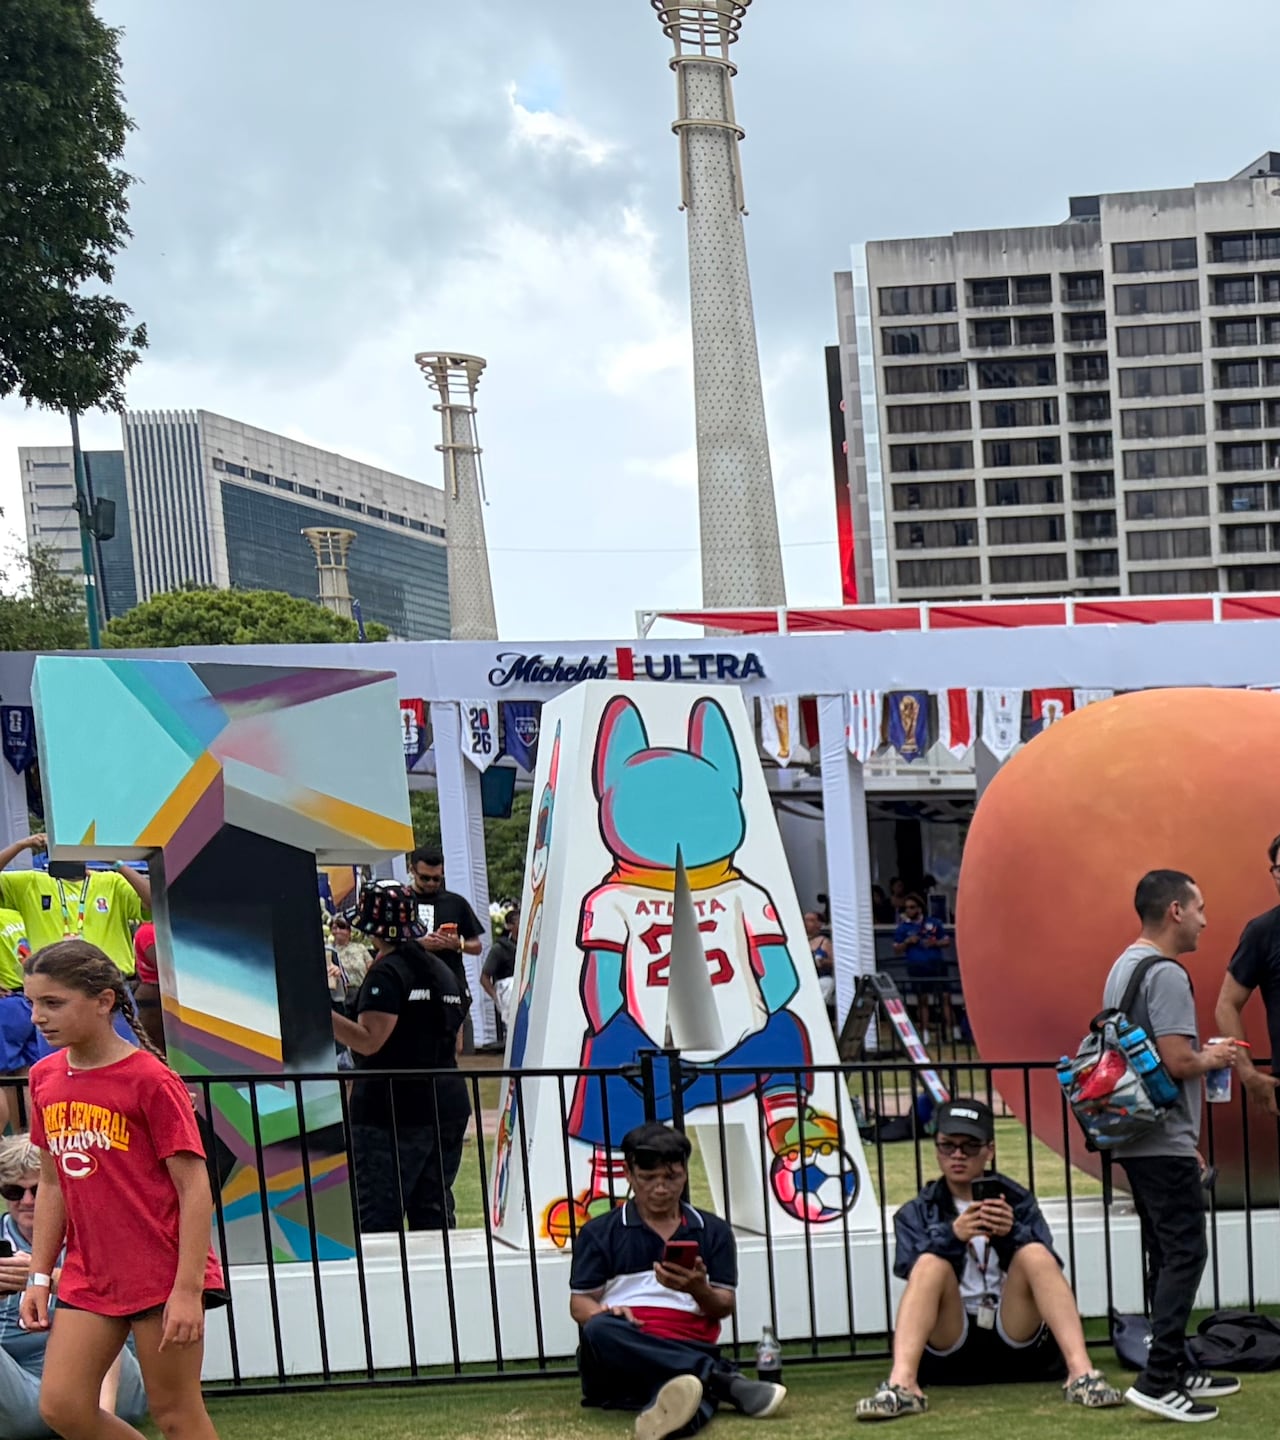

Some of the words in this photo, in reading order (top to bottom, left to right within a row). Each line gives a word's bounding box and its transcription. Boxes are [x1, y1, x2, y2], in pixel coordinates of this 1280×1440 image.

[488, 652, 608, 687] Michelob
[643, 652, 767, 682] ULTRA
[471, 732, 492, 755] 26
[70, 1100, 130, 1144] CENTRAL
[61, 1151, 91, 1178] C
